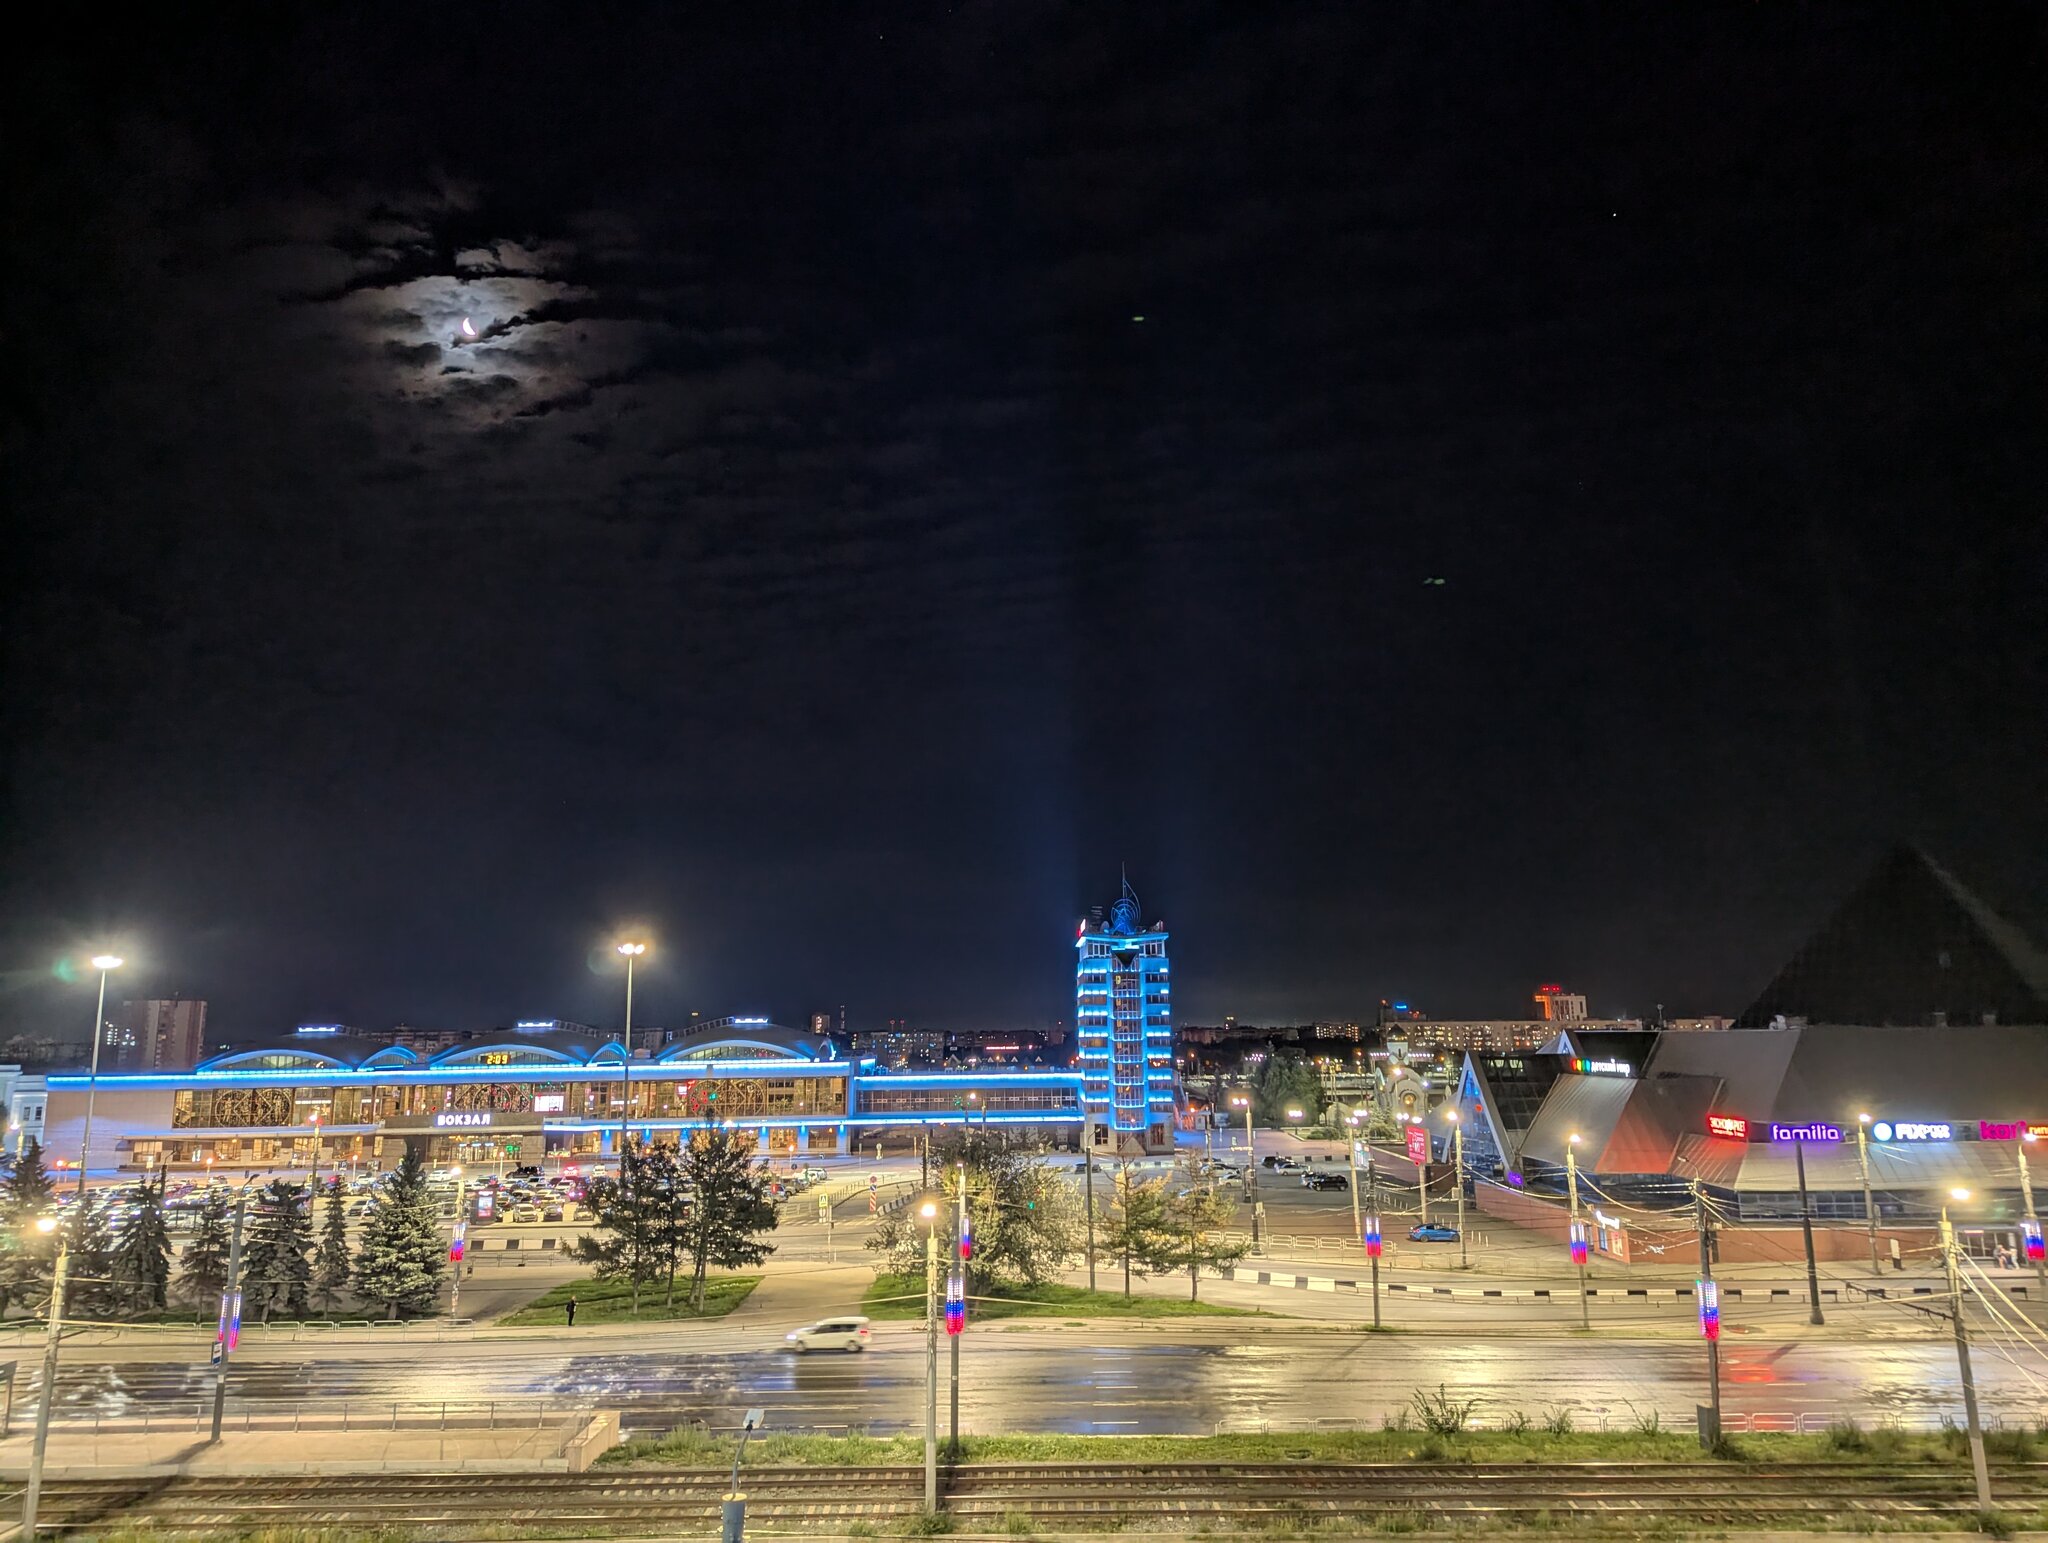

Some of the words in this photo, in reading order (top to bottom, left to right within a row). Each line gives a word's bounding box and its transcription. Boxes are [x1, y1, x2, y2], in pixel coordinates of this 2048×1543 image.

[487, 1055, 508, 1065] 2:09
[437, 1114, 491, 1126] ВОКЗАЛ
[1772, 1125, 1839, 1140] familia
